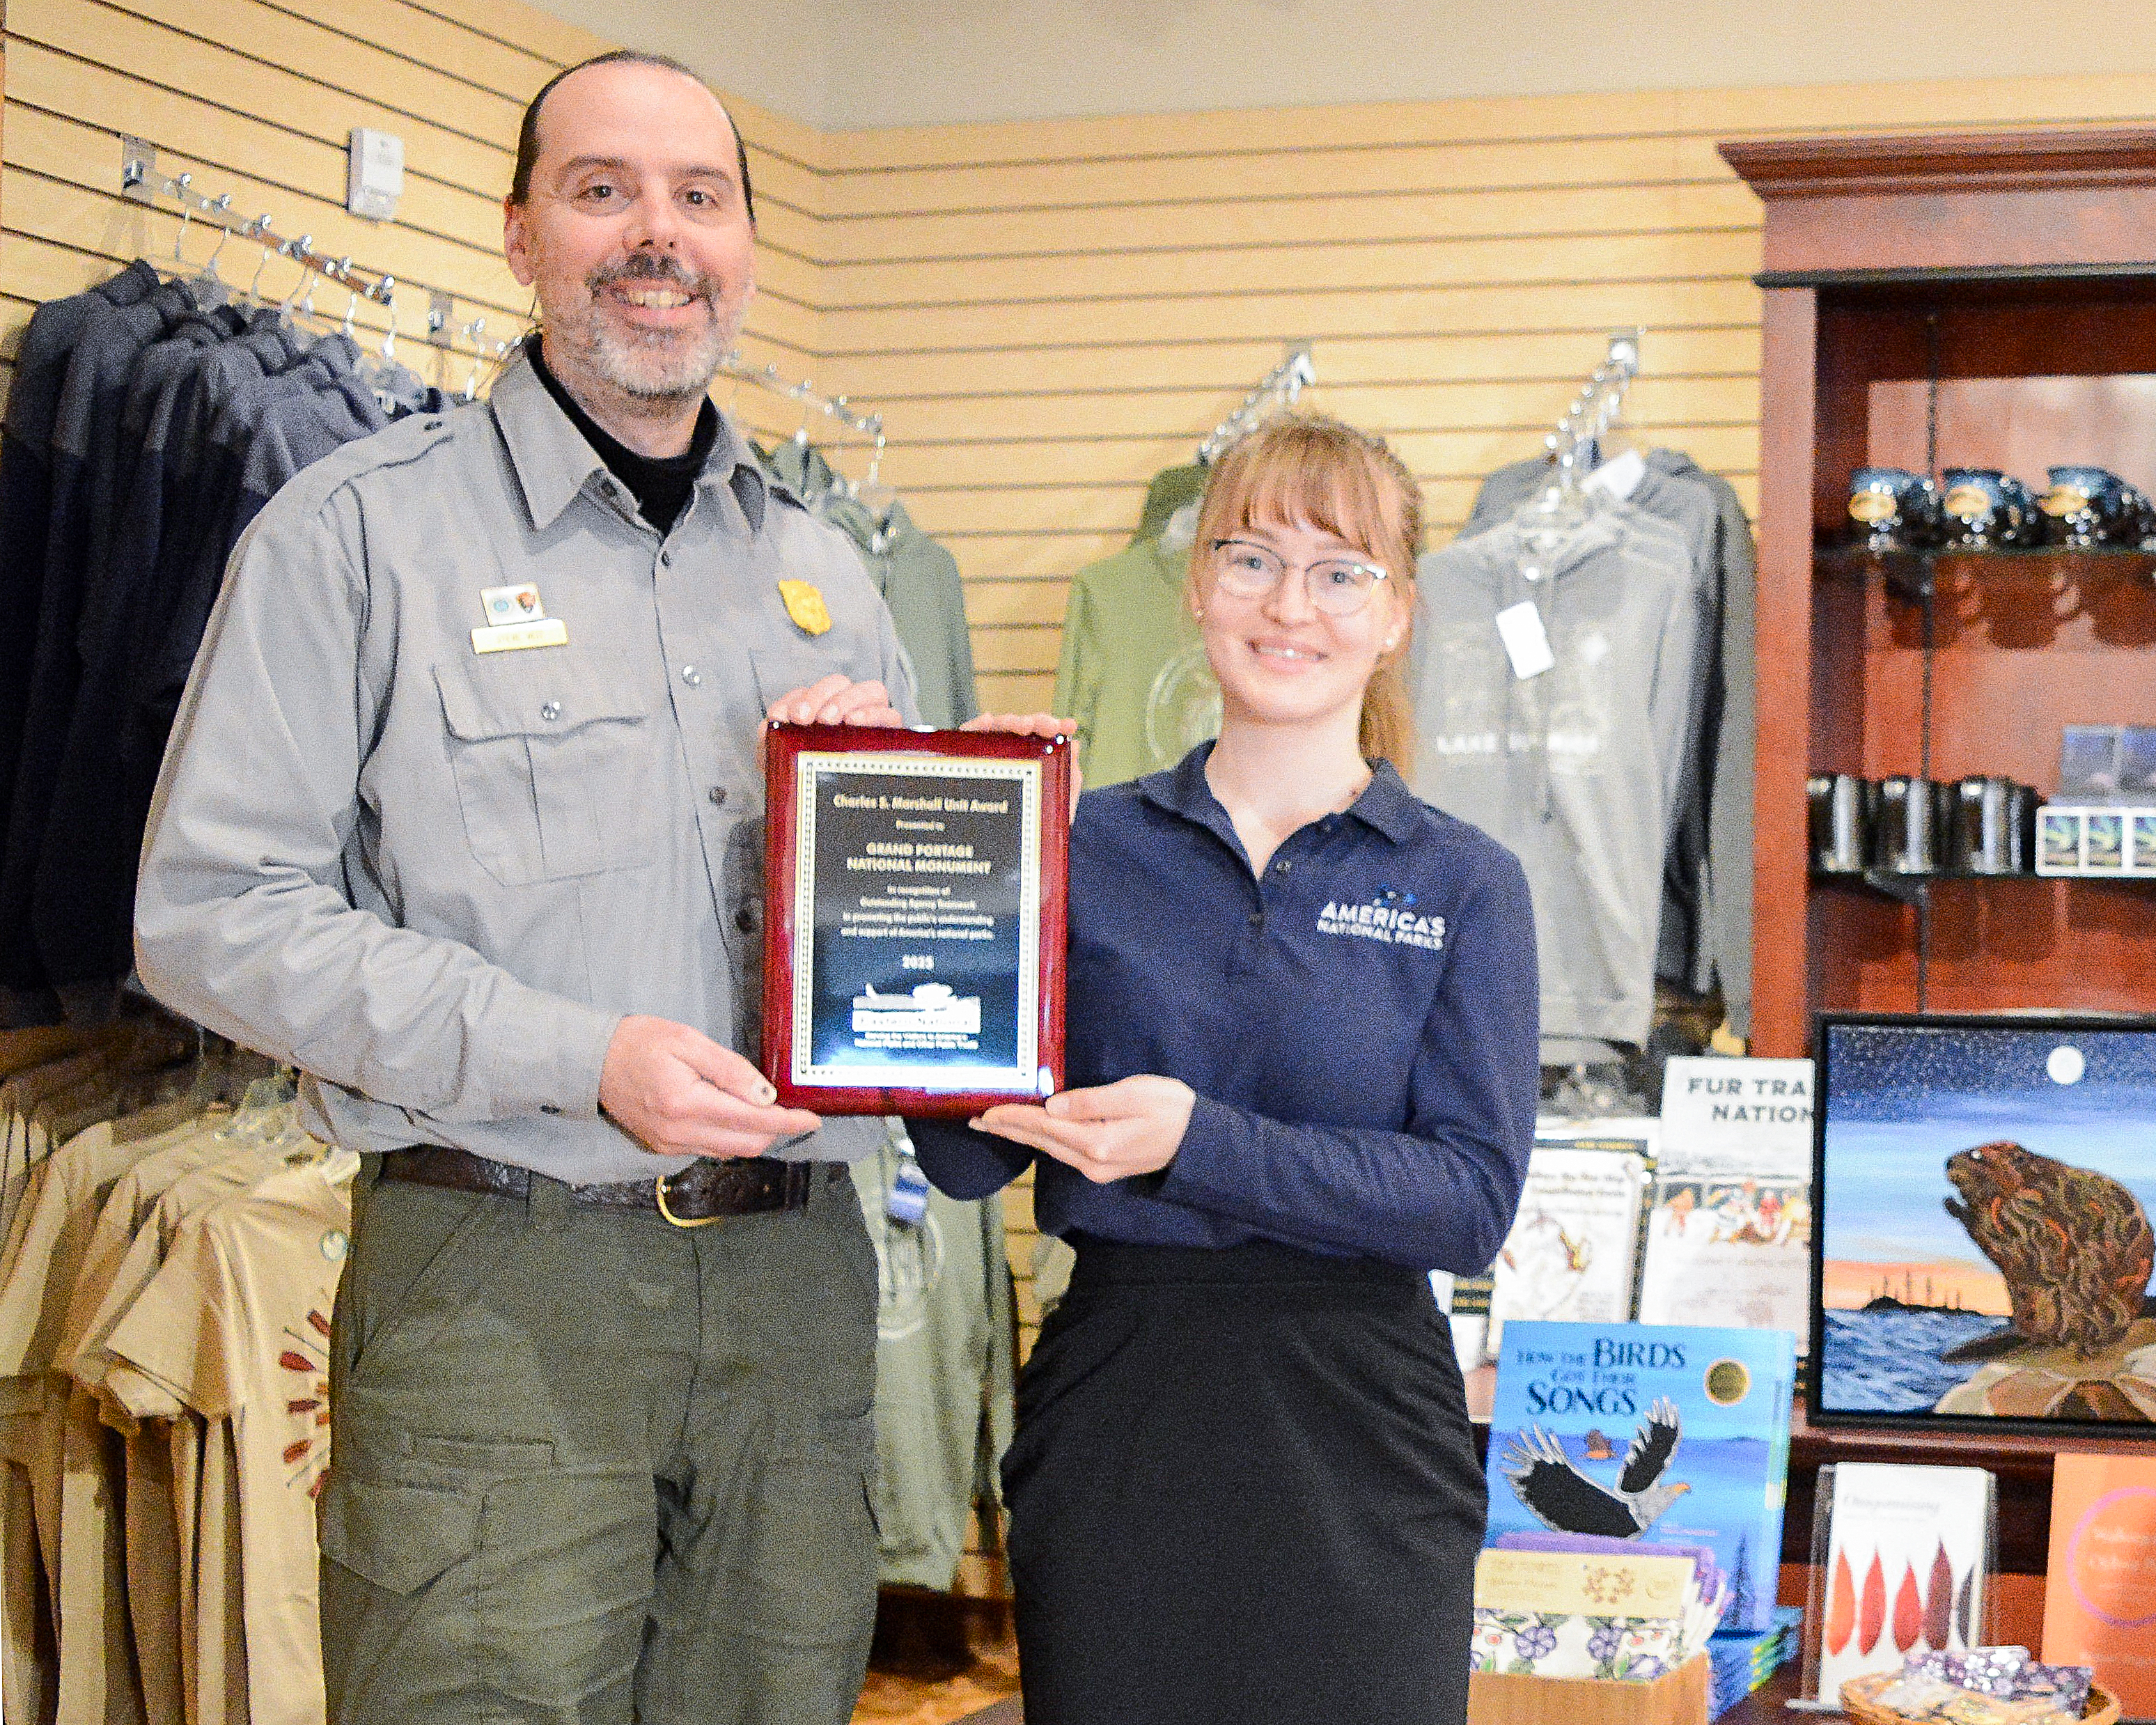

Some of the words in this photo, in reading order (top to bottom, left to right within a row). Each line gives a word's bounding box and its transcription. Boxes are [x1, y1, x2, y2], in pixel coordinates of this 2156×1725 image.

[834, 793, 876, 809] Charles
[891, 795, 943, 812] Marshall
[944, 797, 969, 813] Unit
[969, 799, 1008, 813] Award
[866, 842, 914, 856] GRAND
[916, 844, 974, 859] PORTAGE
[846, 857, 914, 872] NATIONAL
[914, 859, 992, 875] MONUMENT
[941, 886, 951, 896] of
[893, 913, 907, 923] the
[937, 914, 994, 928] understanding
[840, 927, 857, 937] and
[1316, 919, 1393, 945] NATIONAL
[1395, 930, 1444, 951] PARKS
[1687, 1077, 1742, 1095] FUR
[1593, 1336, 1687, 1369] BIRDS
[1525, 1378, 1636, 1416] SONGS
